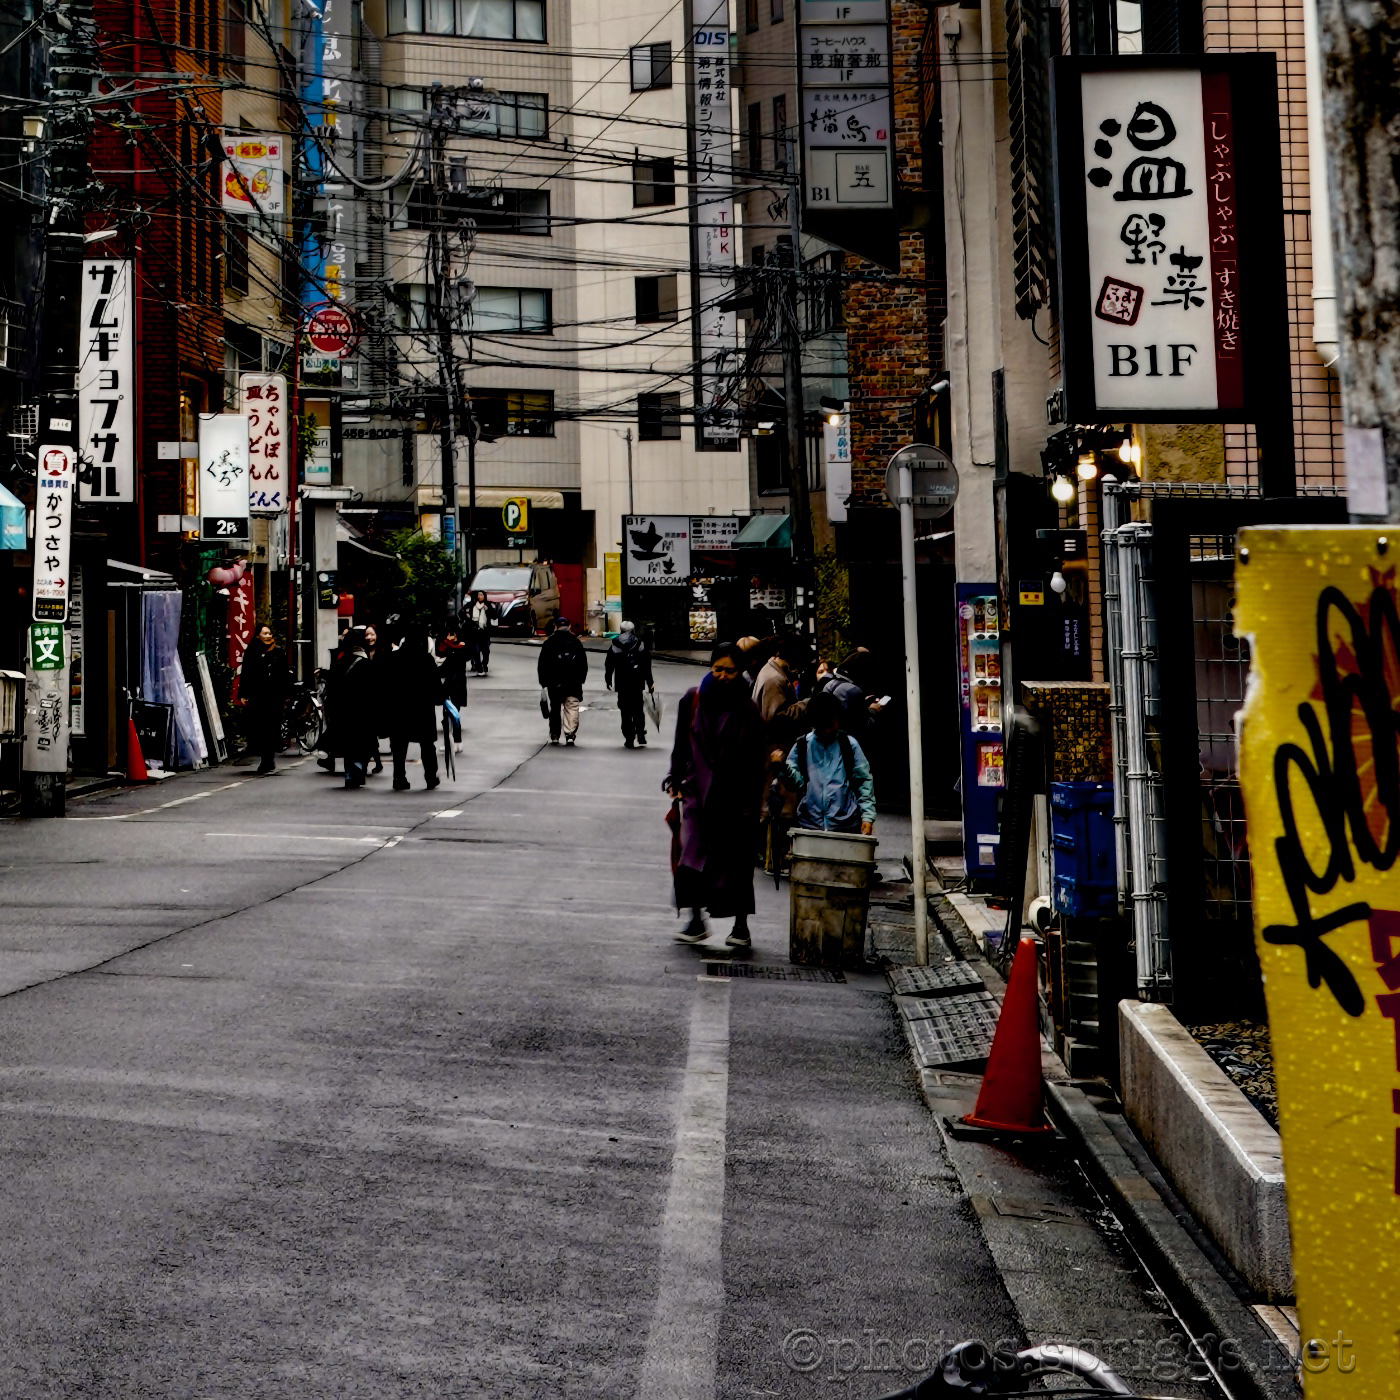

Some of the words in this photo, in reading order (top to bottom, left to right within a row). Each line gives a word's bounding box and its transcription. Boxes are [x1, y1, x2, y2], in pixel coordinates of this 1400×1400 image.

[694, 31, 727, 45] DIS
[810, 37, 867, 46] コーヒーハウス
[268, 201, 281, 211] 3F
[811, 187, 831, 201] B1
[1087, 100, 1208, 311] 温野菜
[1107, 344, 1198, 378] B1F
[87, 264, 126, 498] サムギョプサル
[264, 384, 281, 481] ちゃんぽん
[44, 492, 63, 572] かづさや
[35, 636, 61, 663] 文
